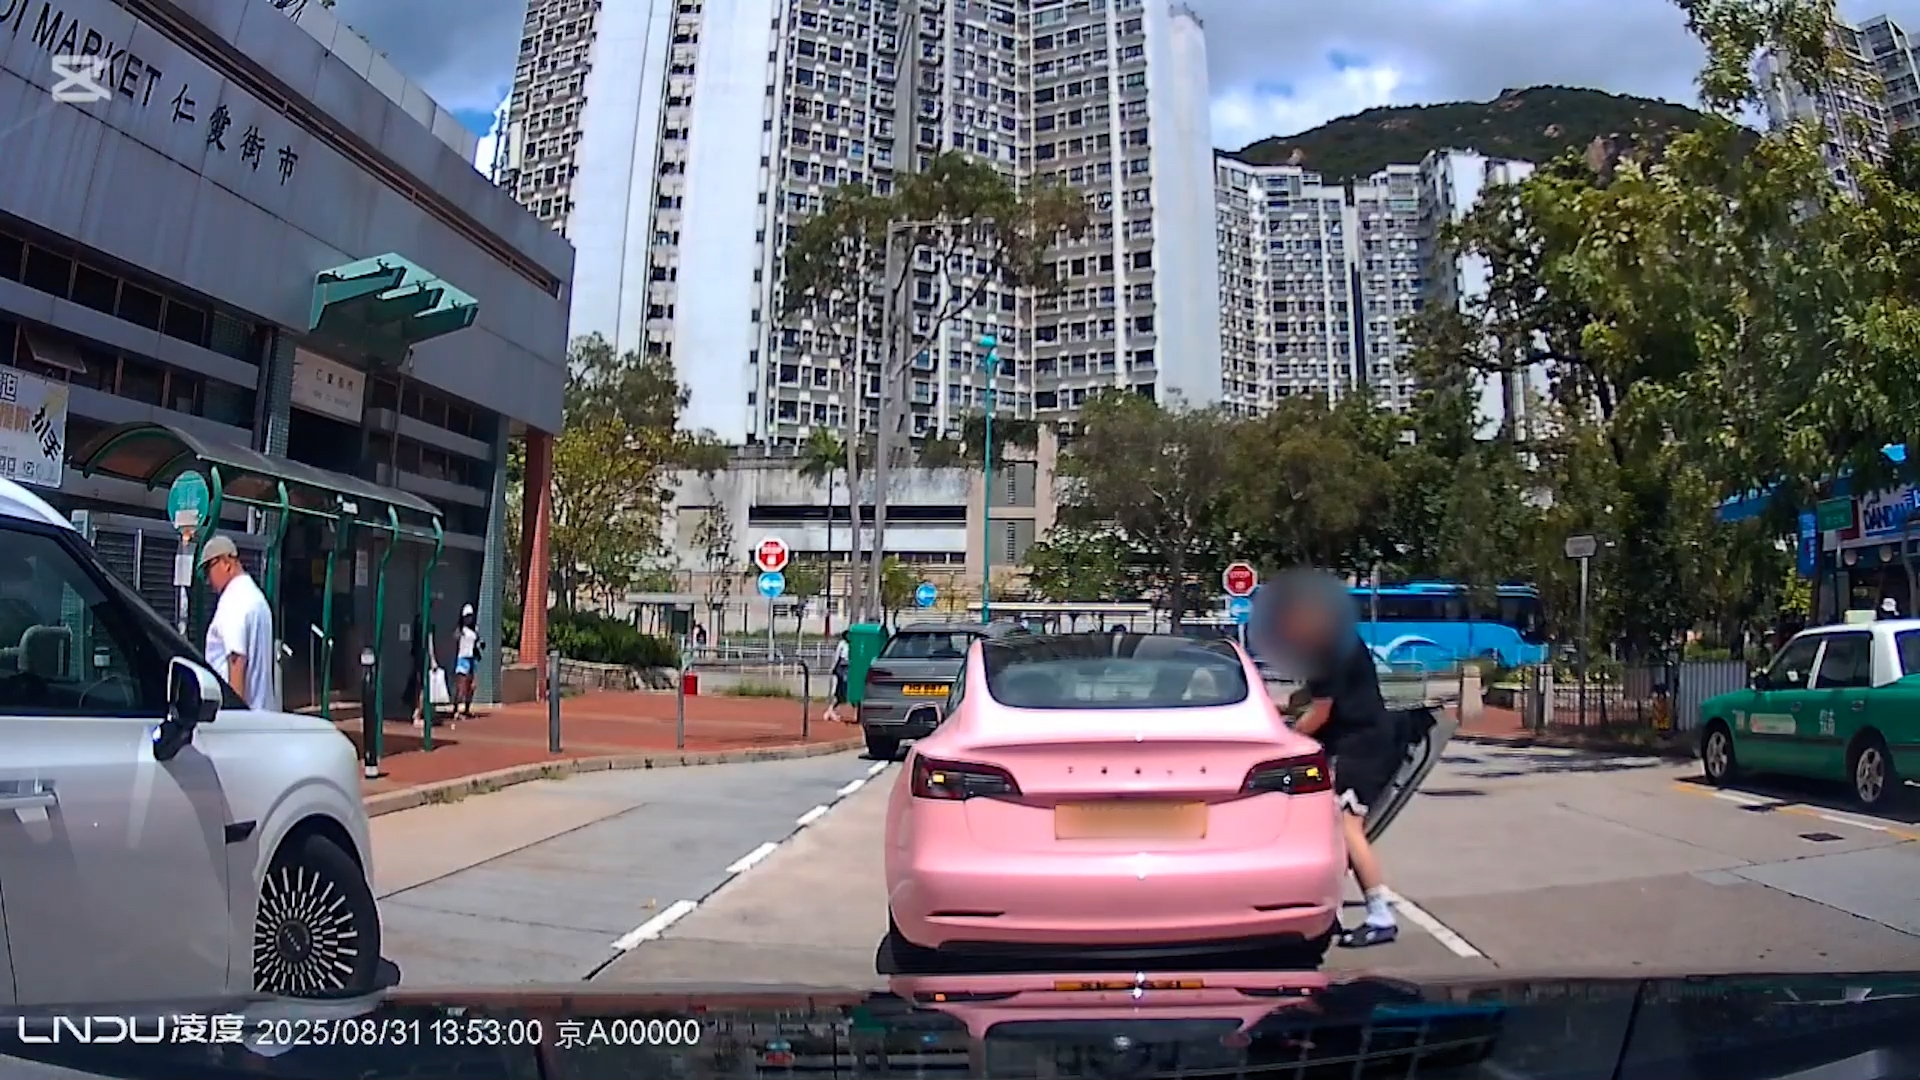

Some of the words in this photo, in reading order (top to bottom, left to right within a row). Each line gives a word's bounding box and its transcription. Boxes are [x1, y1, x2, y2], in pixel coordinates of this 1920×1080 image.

[32, 2, 162, 107] MARKET
[171, 84, 299, 186] 仁愛街市
[31, 404, 62, 463] 扒手
